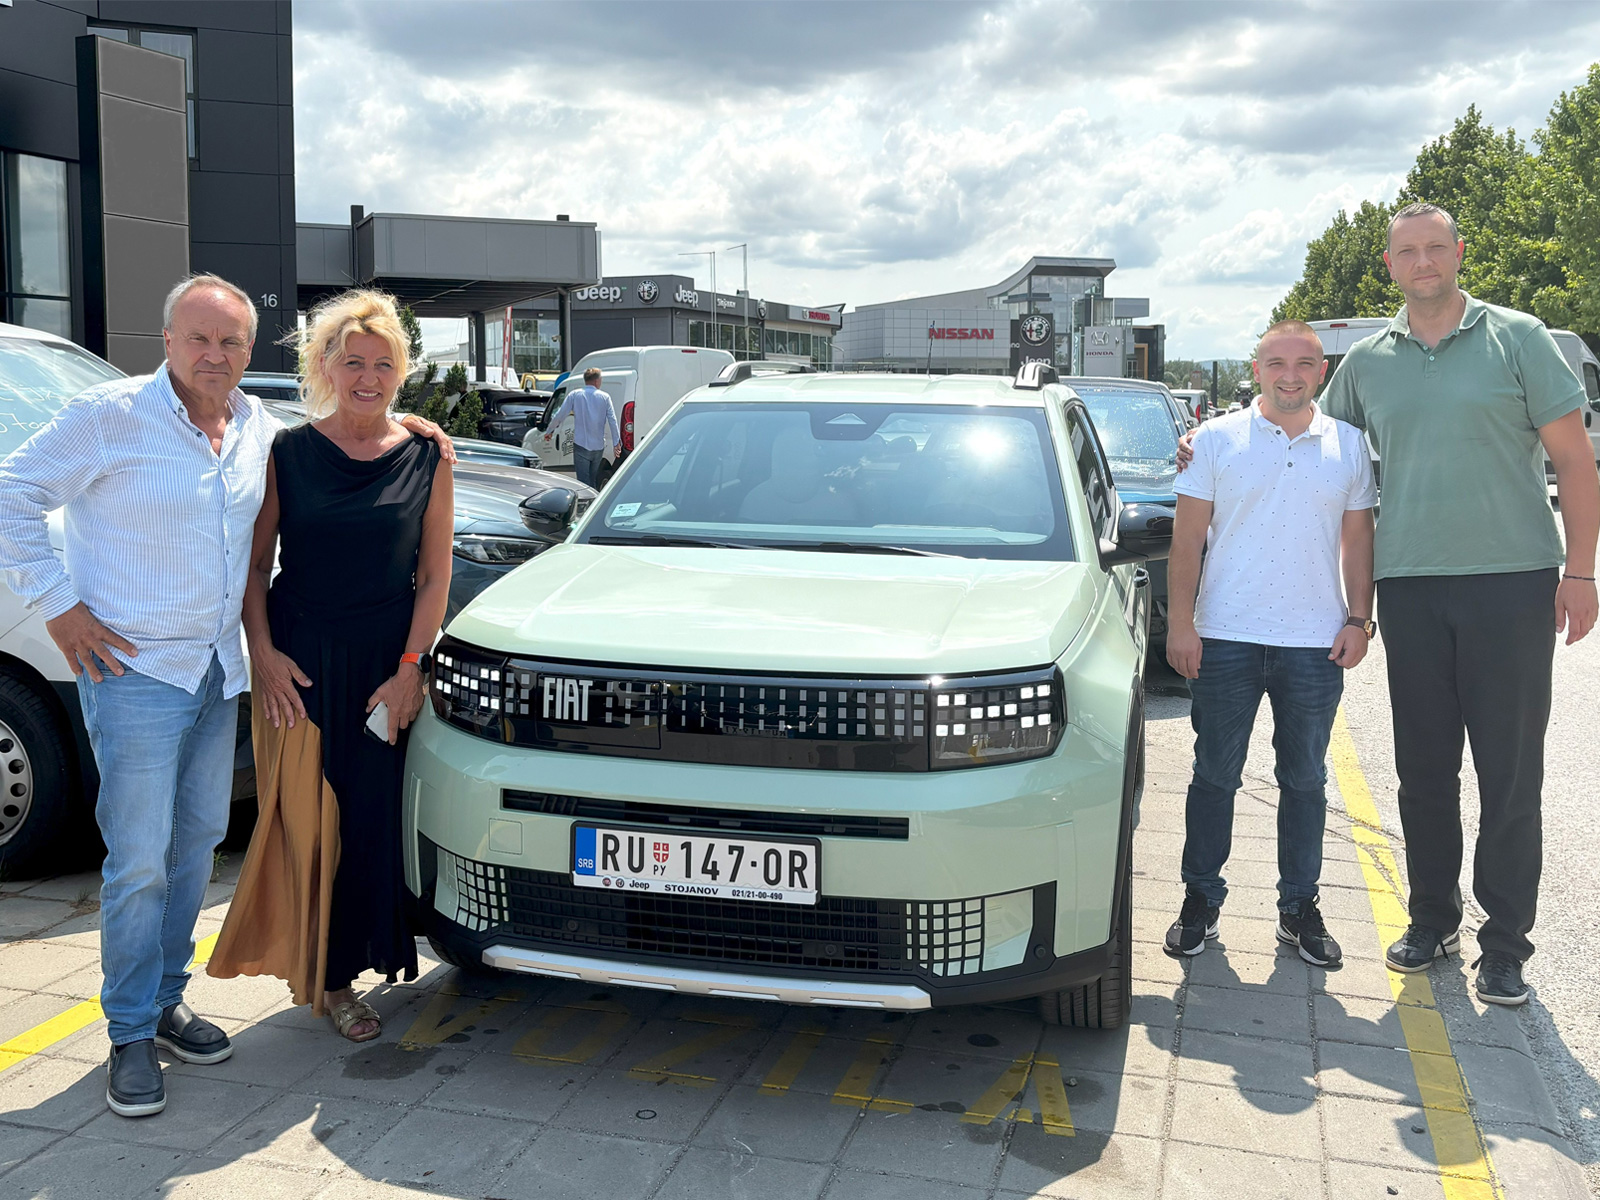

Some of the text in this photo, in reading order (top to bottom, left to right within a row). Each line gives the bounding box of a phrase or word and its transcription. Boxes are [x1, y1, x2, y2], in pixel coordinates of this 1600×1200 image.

[260, 293, 278, 308] 16
[576, 286, 622, 302] Jeep
[676, 284, 699, 308] Jeep
[928, 327, 994, 340] NISSAN
[543, 677, 593, 721] FIAT
[602, 834, 645, 873] RU
[578, 858, 594, 869] SRB
[629, 880, 783, 901] Jeep STOJANOV 021/21-00-490
